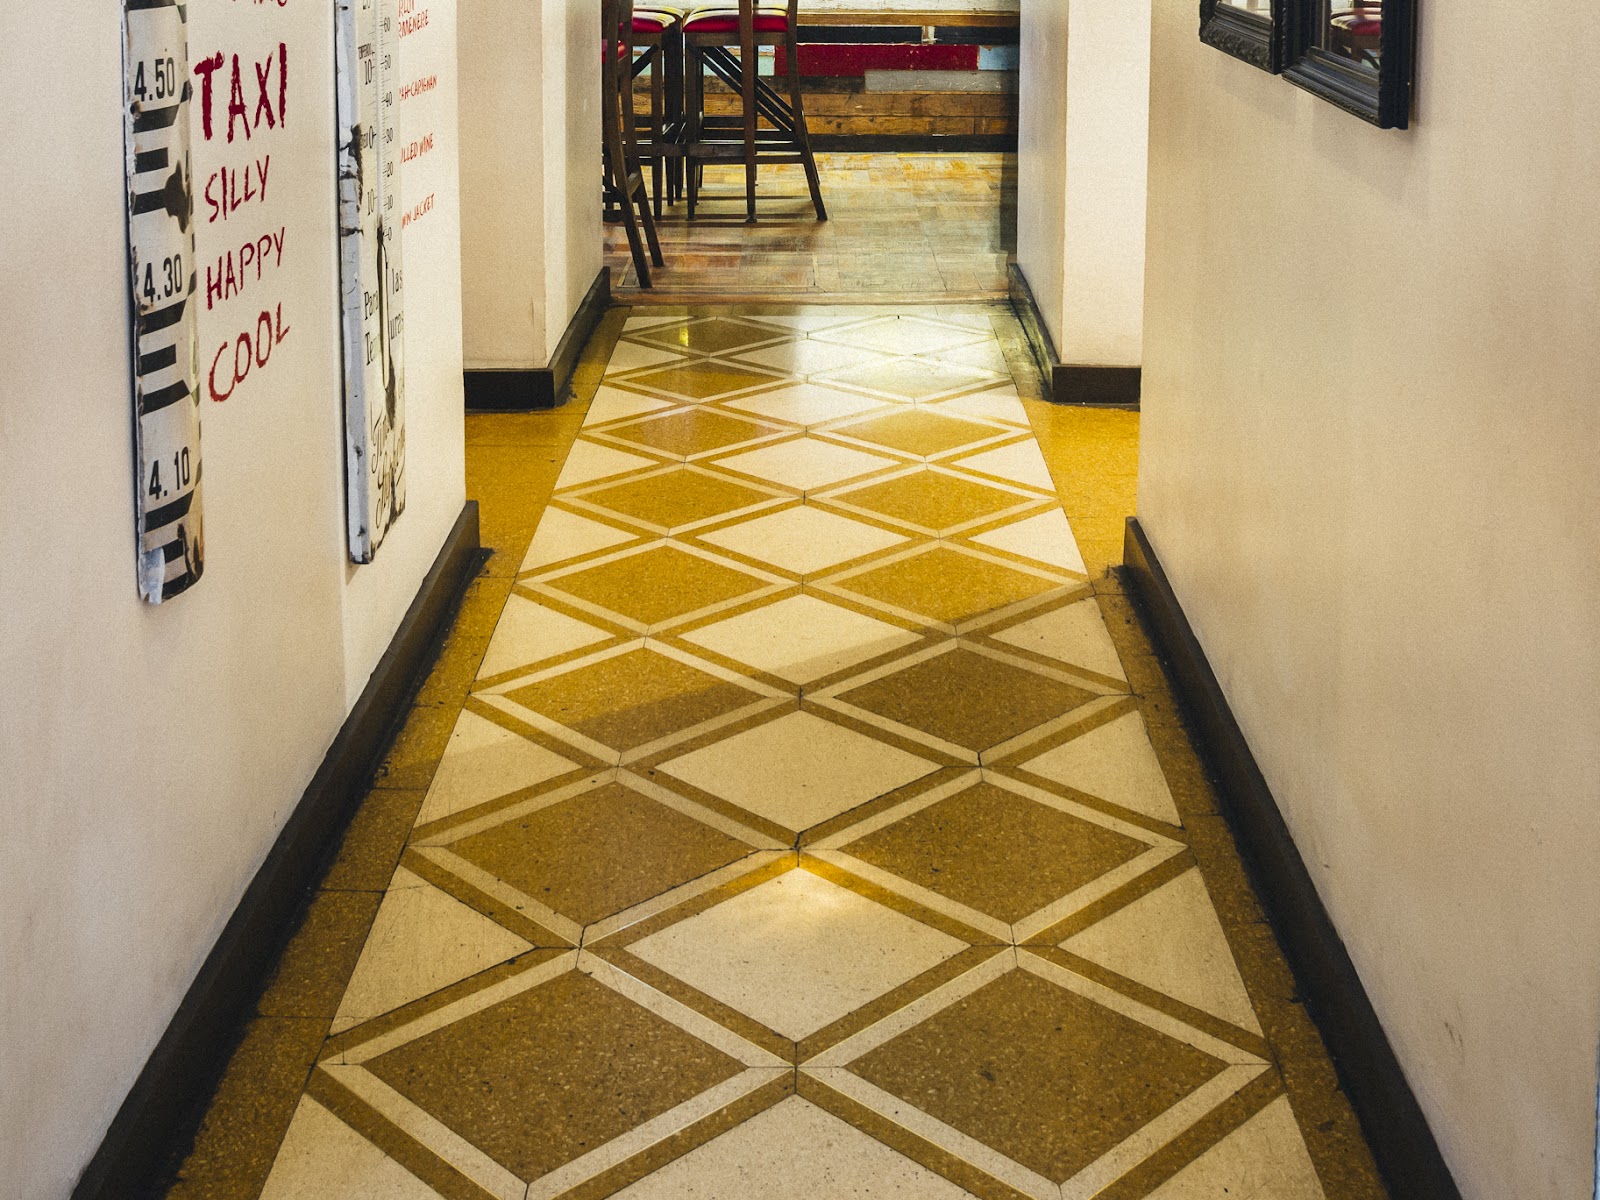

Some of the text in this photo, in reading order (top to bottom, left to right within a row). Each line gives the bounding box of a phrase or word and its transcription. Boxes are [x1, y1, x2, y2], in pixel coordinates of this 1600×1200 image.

[383, 16, 390, 33] 60
[134, 56, 176, 102] 4.50
[194, 42, 287, 144] TAXI
[364, 59, 373, 86] 10
[384, 91, 392, 107] 40
[386, 127, 393, 143] 30
[205, 154, 270, 223] SILLY
[386, 161, 393, 177] 20
[367, 188, 374, 216] 10
[142, 253, 183, 302] 4.30
[206, 226, 285, 310] HAPPY
[208, 302, 291, 403] COOL
[149, 446, 191, 500] 4.10
